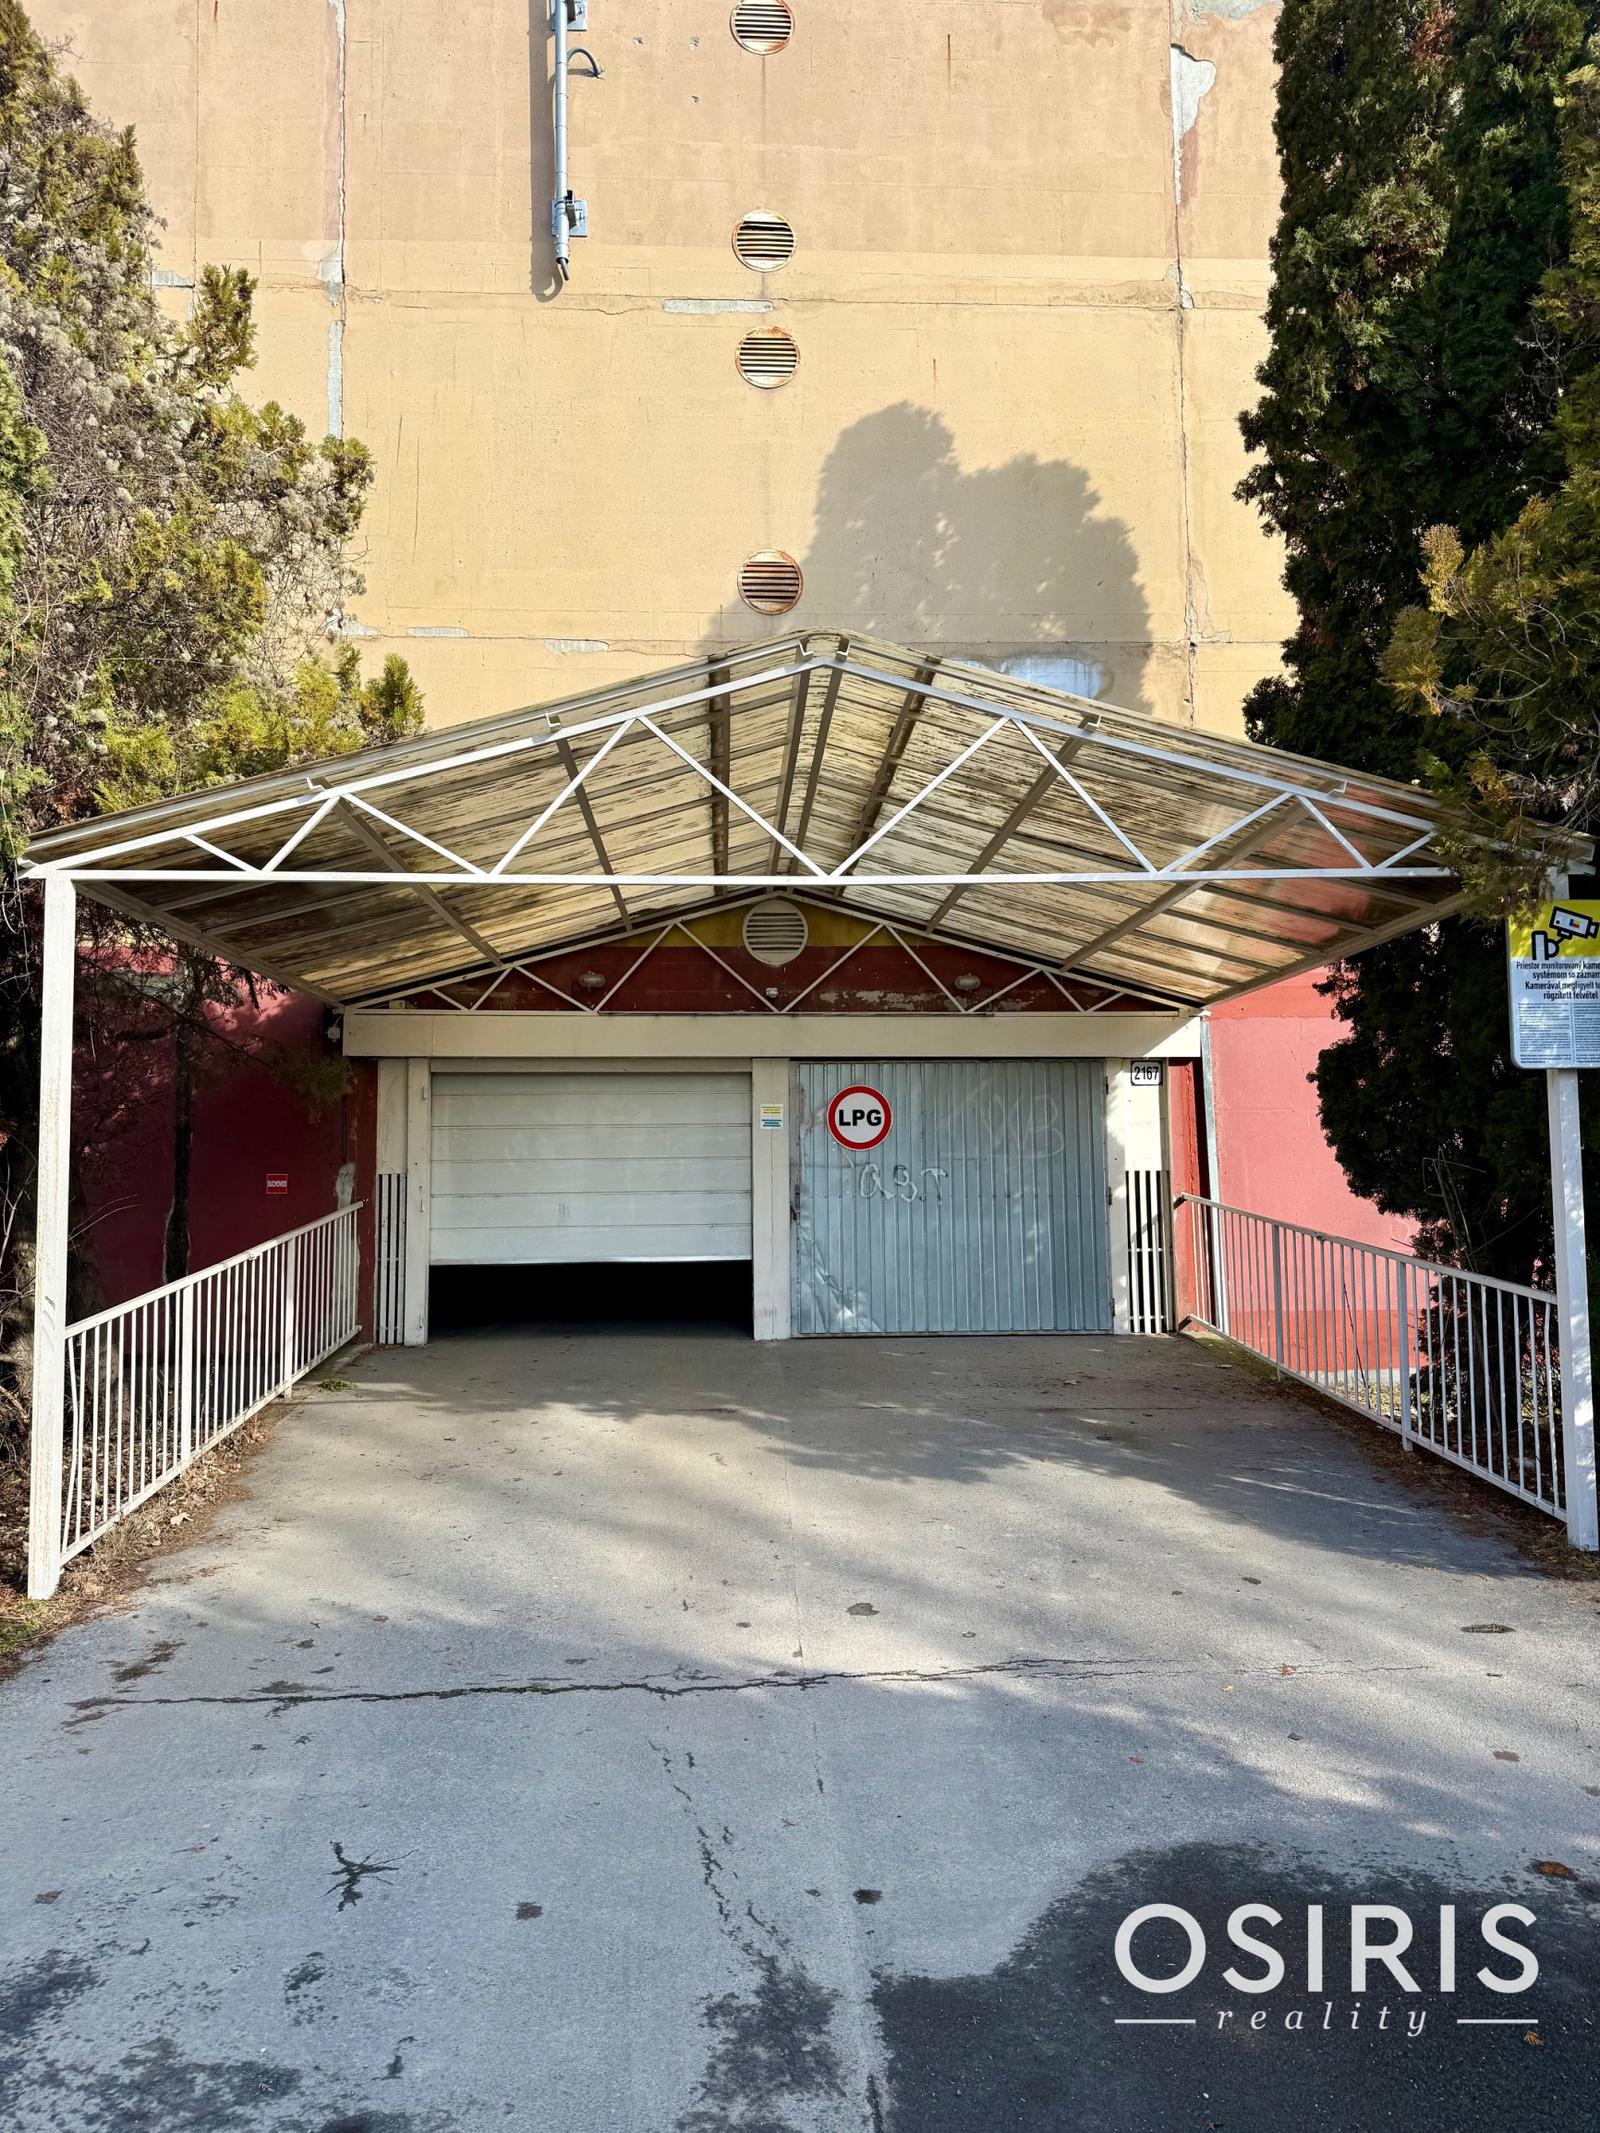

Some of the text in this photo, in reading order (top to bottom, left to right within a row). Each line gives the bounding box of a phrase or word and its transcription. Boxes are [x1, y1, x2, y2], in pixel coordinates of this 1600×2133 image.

[1516, 961, 1540, 970] Priestor
[1532, 970, 1567, 980] systémom
[1525, 980, 1561, 990] Kamerával
[1543, 990, 1598, 1001] rögzített felvétel
[1134, 1066, 1159, 1080] 2167
[838, 1109, 882, 1127] LPG
